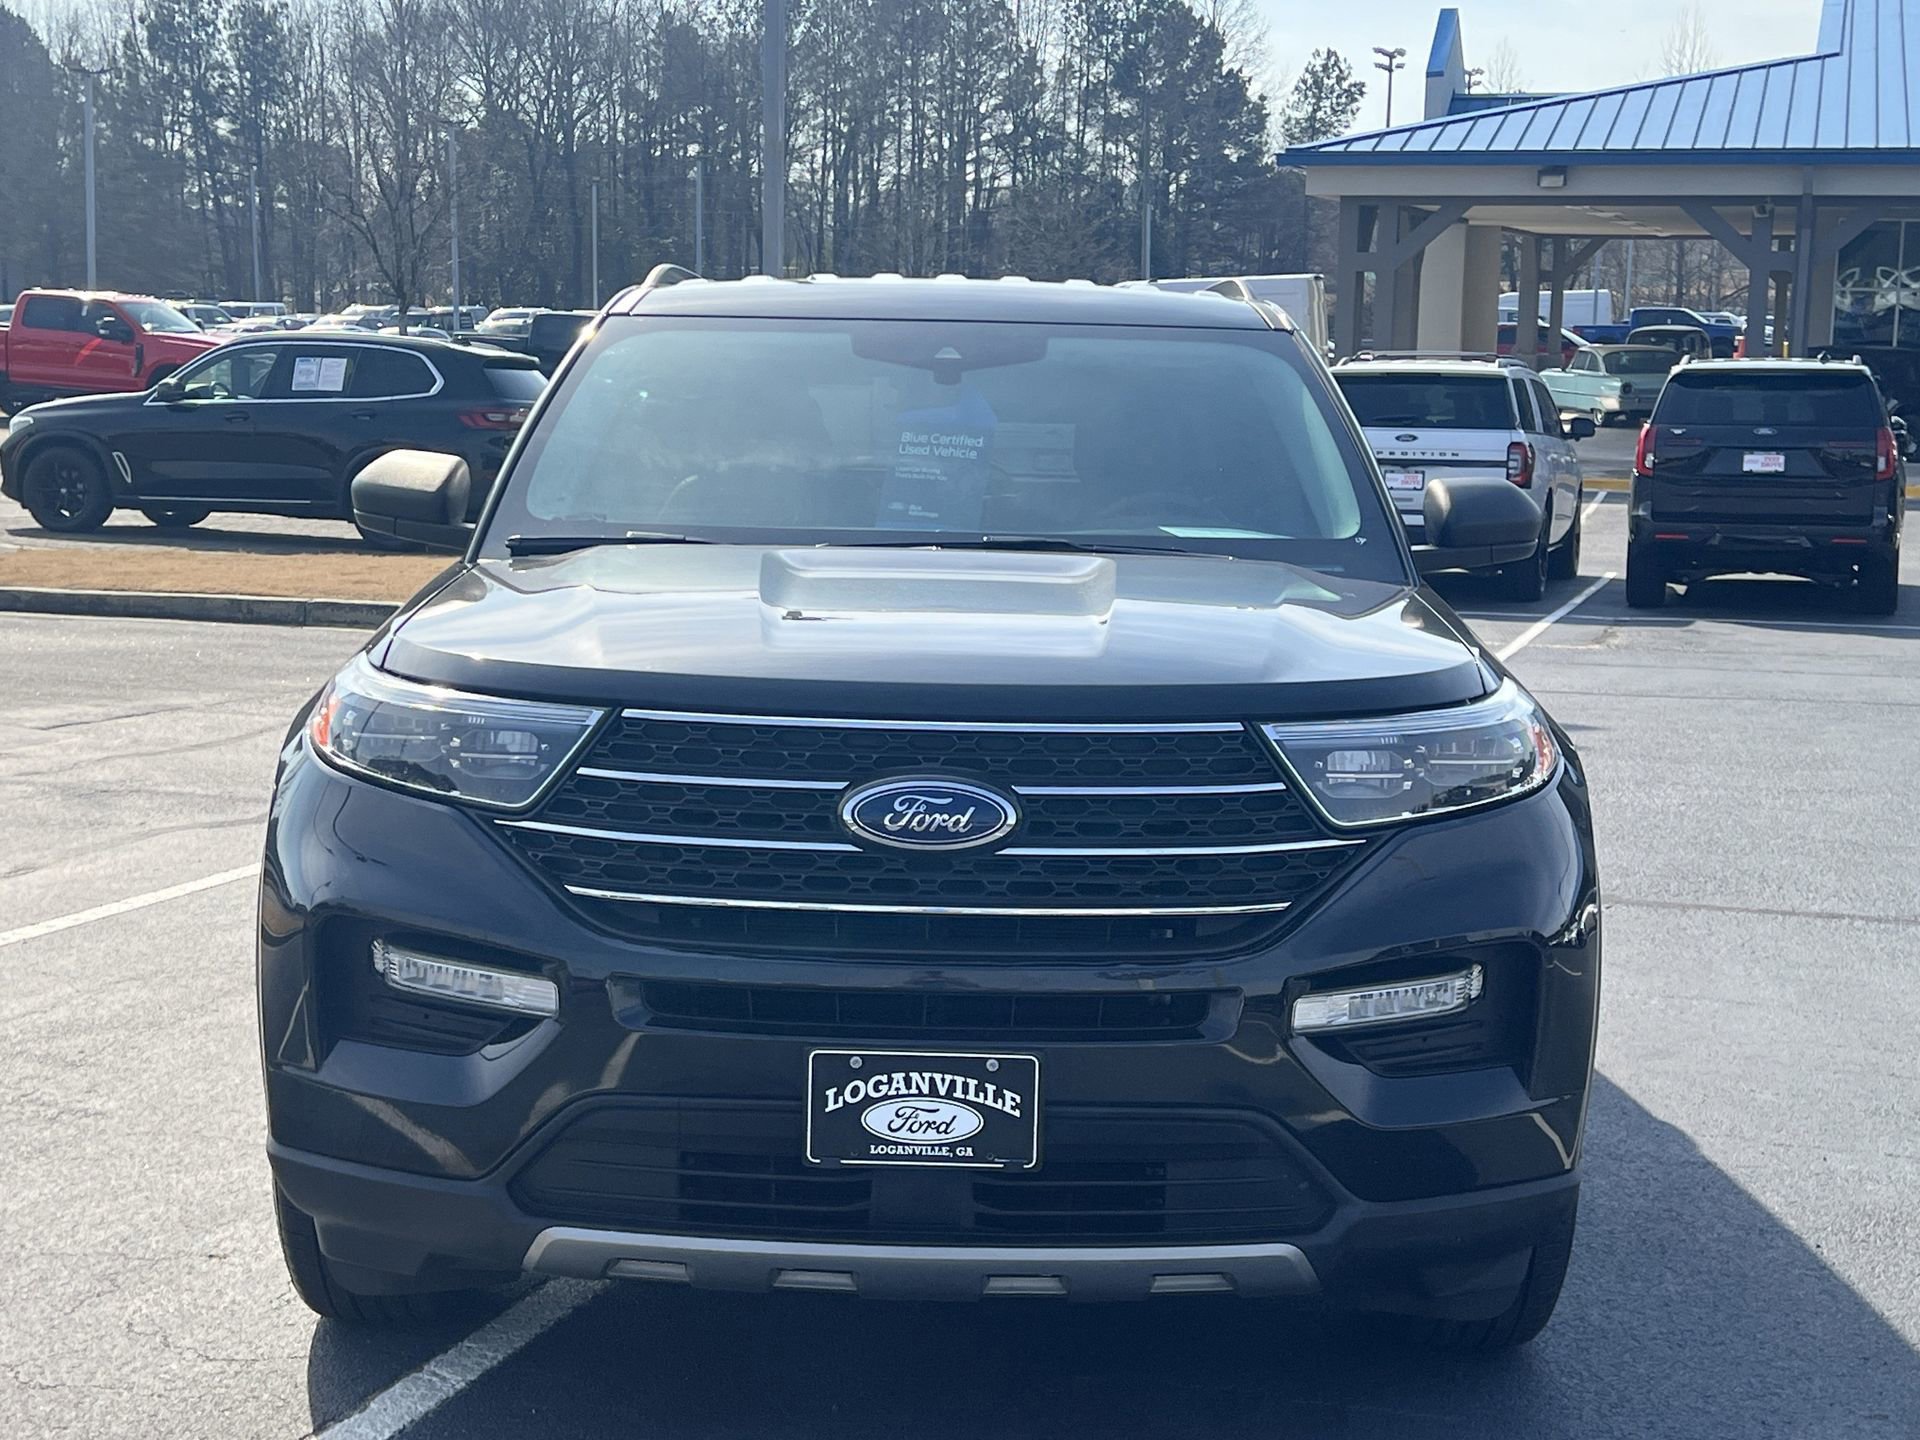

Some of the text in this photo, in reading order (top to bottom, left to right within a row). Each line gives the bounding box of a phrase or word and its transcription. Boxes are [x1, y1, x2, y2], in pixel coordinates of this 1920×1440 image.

[901, 431, 985, 448] Blue Certified
[899, 444, 978, 460] Used Vehicle
[883, 794, 976, 833] Ford
[824, 1071, 1022, 1119] LOGANVILLE
[887, 1105, 957, 1136] Ford
[870, 1143, 974, 1158] LOGANVILLE, GA
